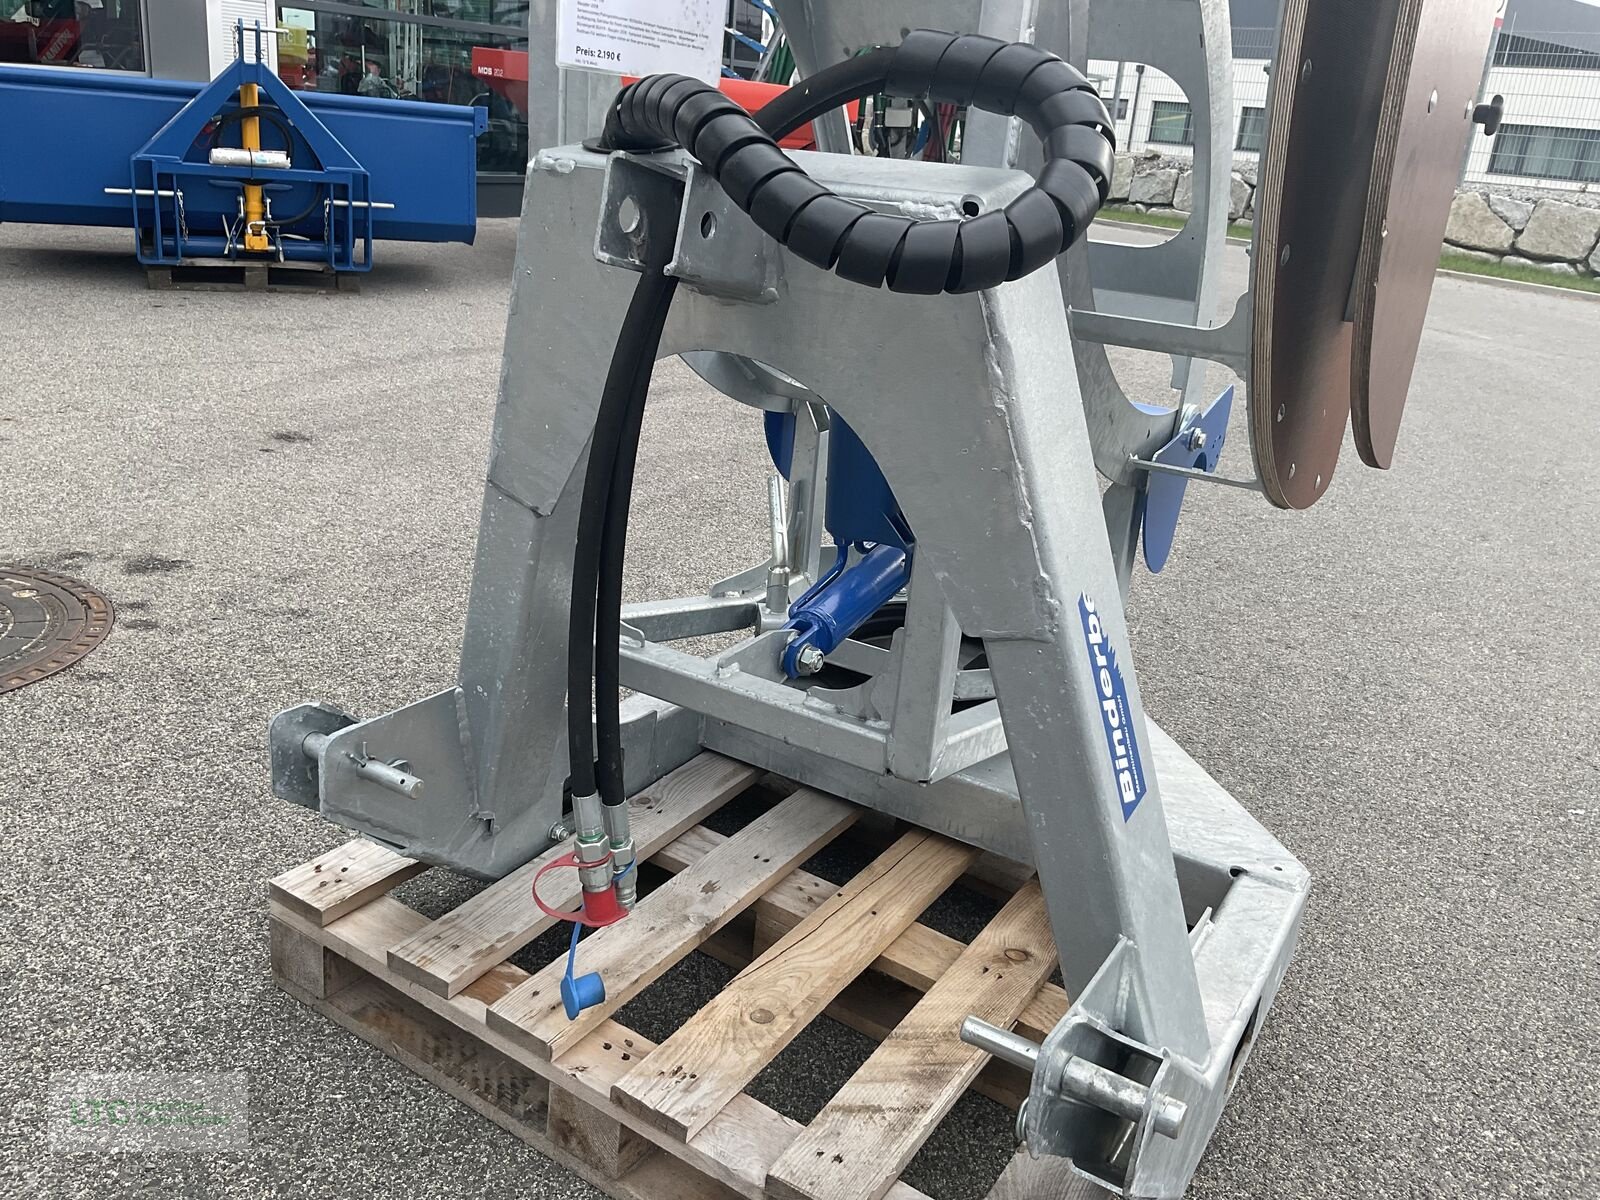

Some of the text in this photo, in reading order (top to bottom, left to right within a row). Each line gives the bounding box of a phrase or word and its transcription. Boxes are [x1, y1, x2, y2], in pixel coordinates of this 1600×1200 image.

[575, 45, 621, 62] Preis: 2.190 €
[477, 66, 493, 75] MDS
[1116, 694, 1141, 794] Maschinenbau GmbH
